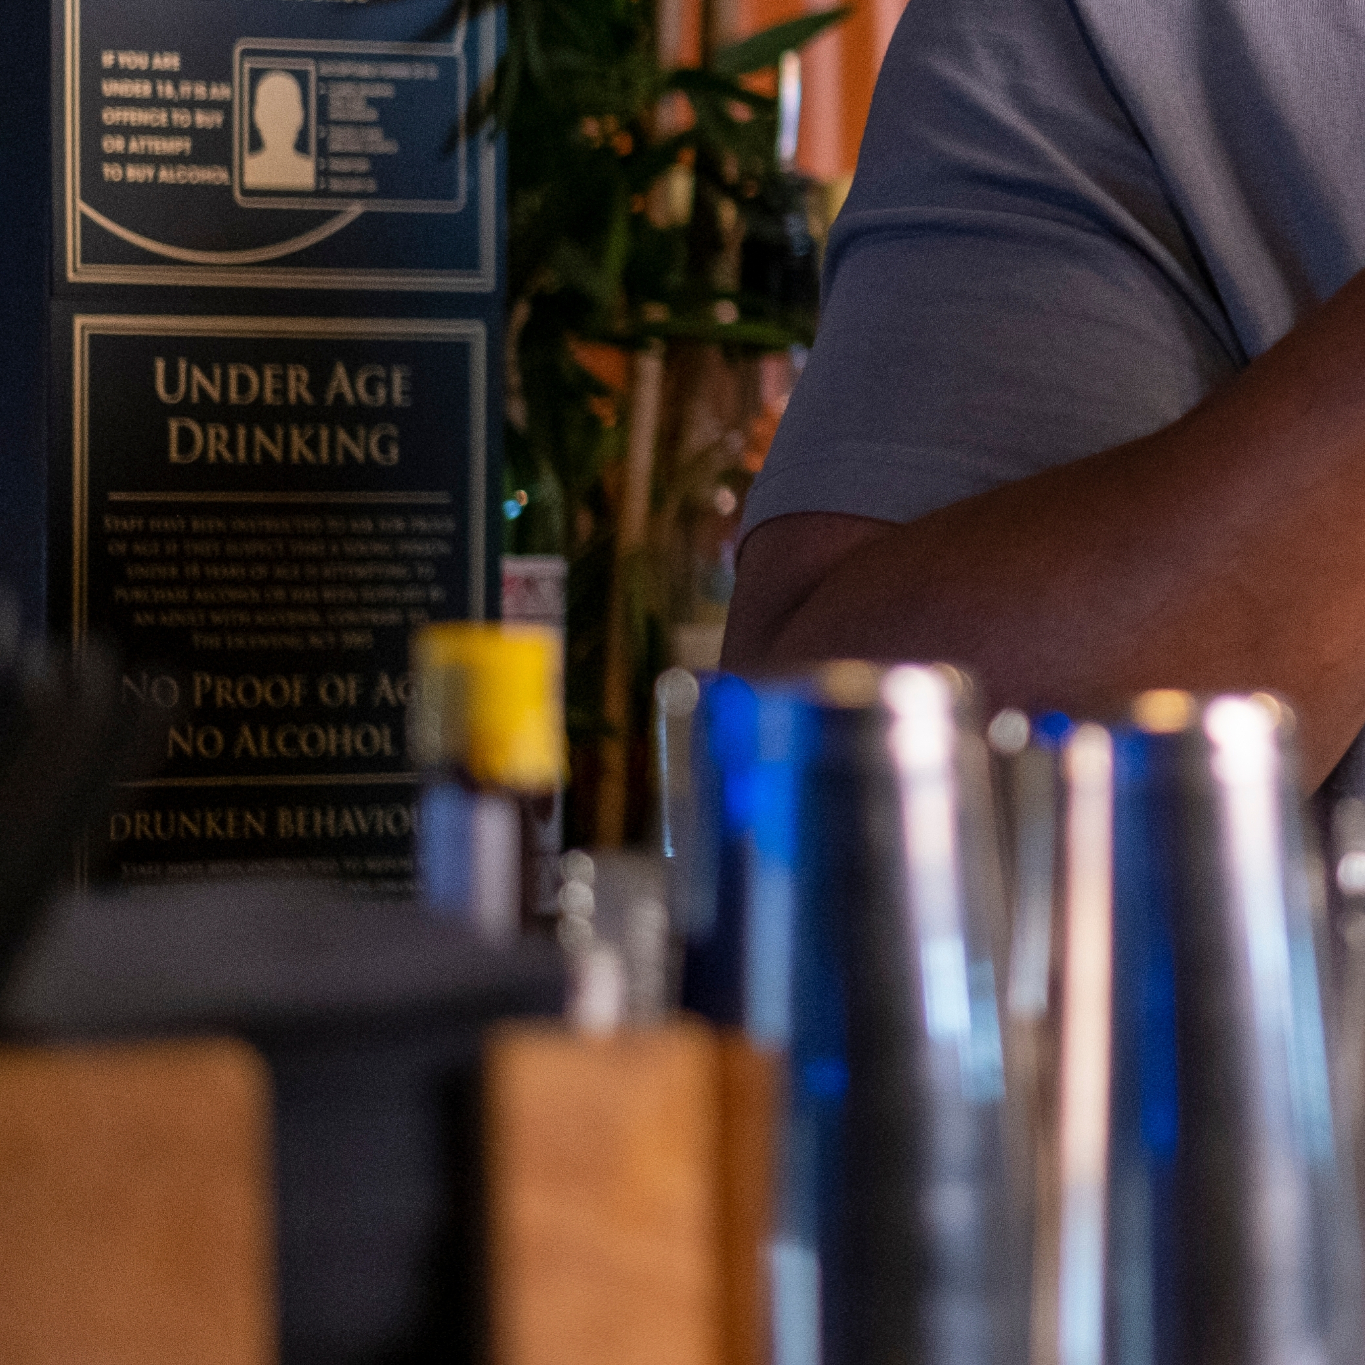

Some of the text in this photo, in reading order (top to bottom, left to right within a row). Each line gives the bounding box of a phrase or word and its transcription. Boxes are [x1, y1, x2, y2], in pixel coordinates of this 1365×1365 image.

[102, 50, 181, 73] IF YOU ARE
[103, 79, 151, 101] UNDER
[154, 356, 412, 409] UNDER AGE
[167, 417, 400, 467] DRINKING
[122, 673, 180, 708] NO
[193, 672, 306, 708] PROOF
[374, 673, 416, 708] AG
[168, 722, 395, 760] NO ALCOHOL
[110, 804, 416, 842] DRUNKEN BEHAVIO
